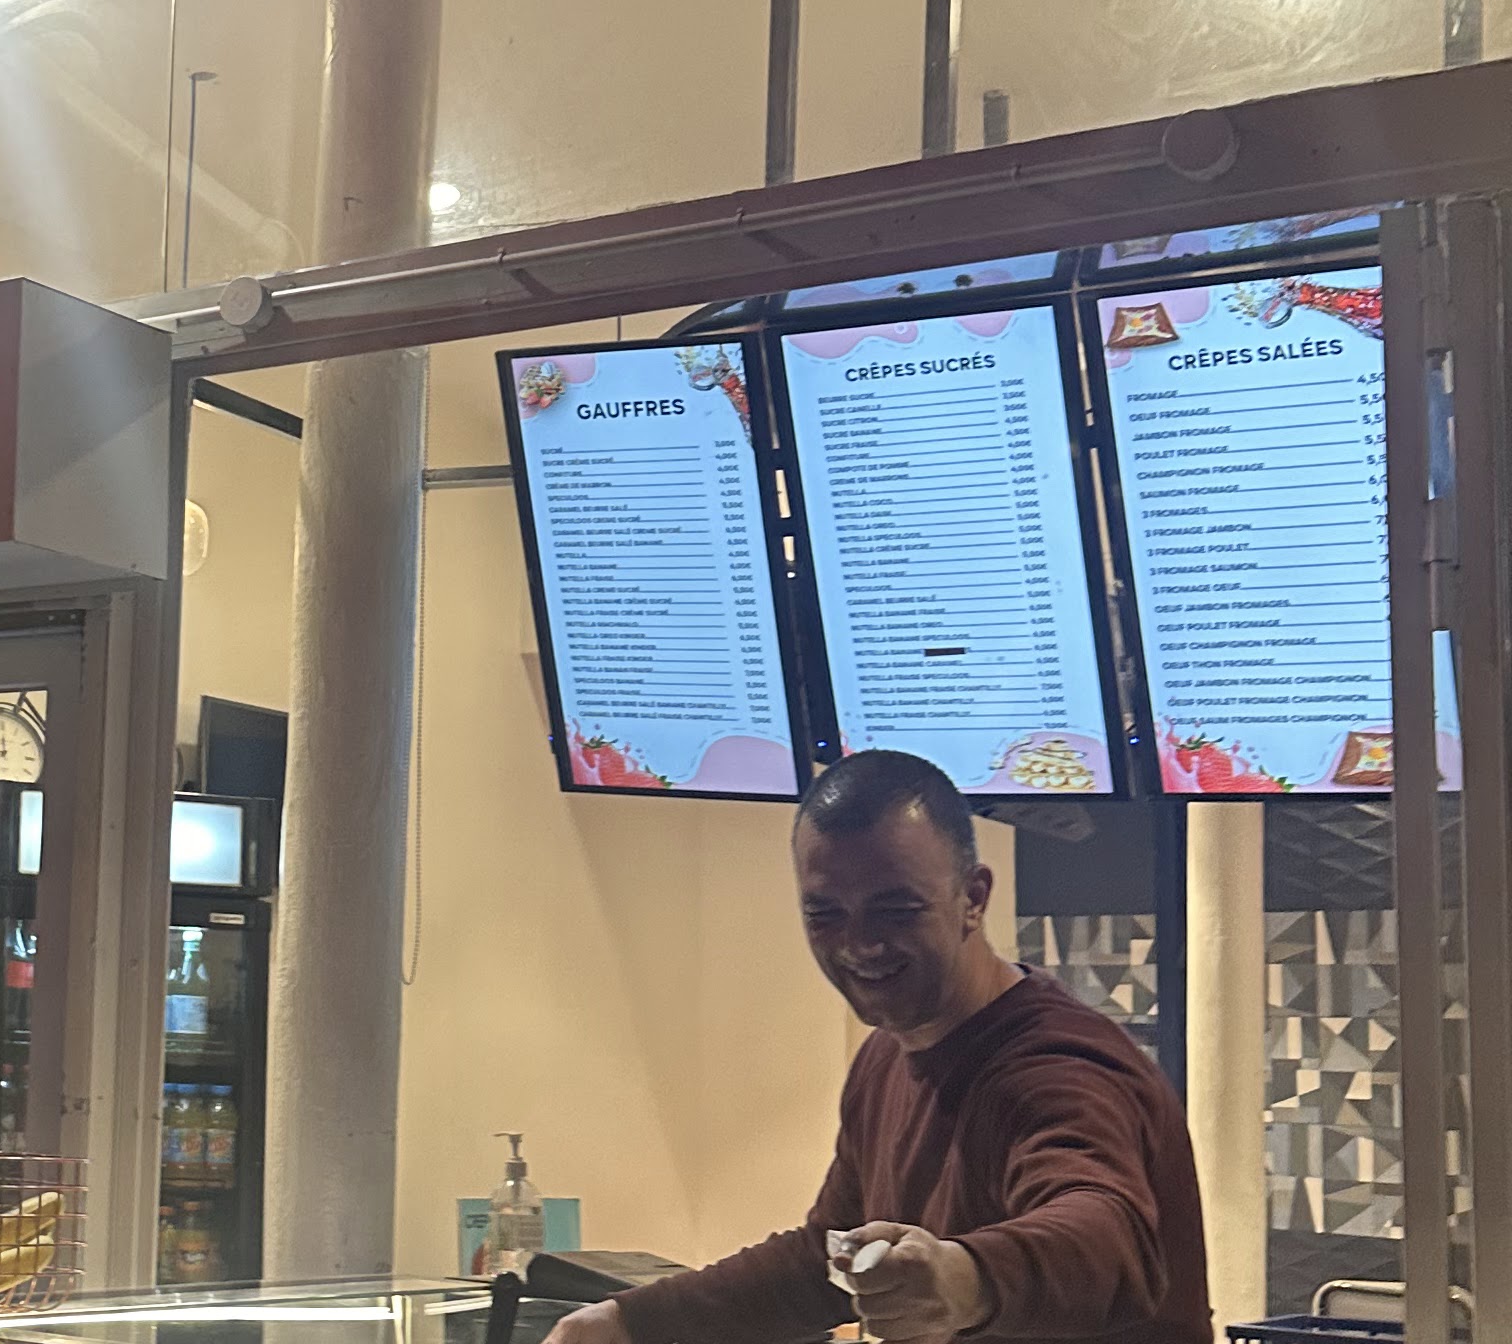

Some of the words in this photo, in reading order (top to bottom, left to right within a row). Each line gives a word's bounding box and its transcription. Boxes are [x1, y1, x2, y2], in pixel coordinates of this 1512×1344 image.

[1168, 348, 1253, 372] CRÊPES
[1257, 337, 1344, 362] SALÉES
[845, 362, 917, 383] CRÊPES
[919, 351, 997, 375] SUCRÉS
[1126, 389, 1178, 403] FROMAGE
[576, 398, 687, 421] GAUFFRES
[1159, 406, 1210, 419] FROMAGE
[1132, 429, 1177, 441] JAMBON
[1179, 425, 1231, 437] FROMAGE
[1134, 449, 1174, 460] POULET
[1176, 445, 1228, 457] FROMAGE
[1136, 466, 1210, 480] CHAMPIGNON
[1212, 462, 1264, 474] FROMAGE
[831, 488, 866, 497] NUTELLA
[1139, 488, 1186, 499] SAUMON
[1187, 484, 1239, 495] FROMAGE
[832, 500, 867, 508] NUTELLA
[834, 512, 869, 520] NUTELLA
[1152, 525, 1204, 536] FROMAGE
[1206, 522, 1251, 533] JAMBON
[838, 534, 872, 542] NUTELLA
[839, 546, 874, 554] NUTELLA
[1154, 545, 1206, 556] FROMAGE
[1208, 542, 1249, 553] POULET
[841, 559, 876, 567] NUTELLA
[1157, 564, 1208, 575] FROMAGE
[1210, 562, 1258, 572] SAUMON
[843, 572, 878, 580] NUTELLA
[1159, 584, 1210, 593] FROMAGE
[1184, 601, 1229, 611] JAMBON
[1186, 621, 1227, 630] POULET
[1228, 619, 1280, 629] FROMAGE
[1188, 639, 1262, 649] CHAMPIGNON
[1264, 637, 1316, 646] FROMAGE
[1191, 659, 1221, 668] THON
[1223, 657, 1274, 667] FROMAGE
[1193, 677, 1238, 686] JAMBON
[1240, 676, 1292, 685] FROMAGE
[1294, 674, 1371, 684] CHAMPIGNON
[1195, 697, 1237, 705] POULET
[1238, 696, 1289, 704] FROMAGE
[1291, 694, 1368, 703] CHAMPIGNON
[1290, 713, 1367, 722] CHAMPIGNON
